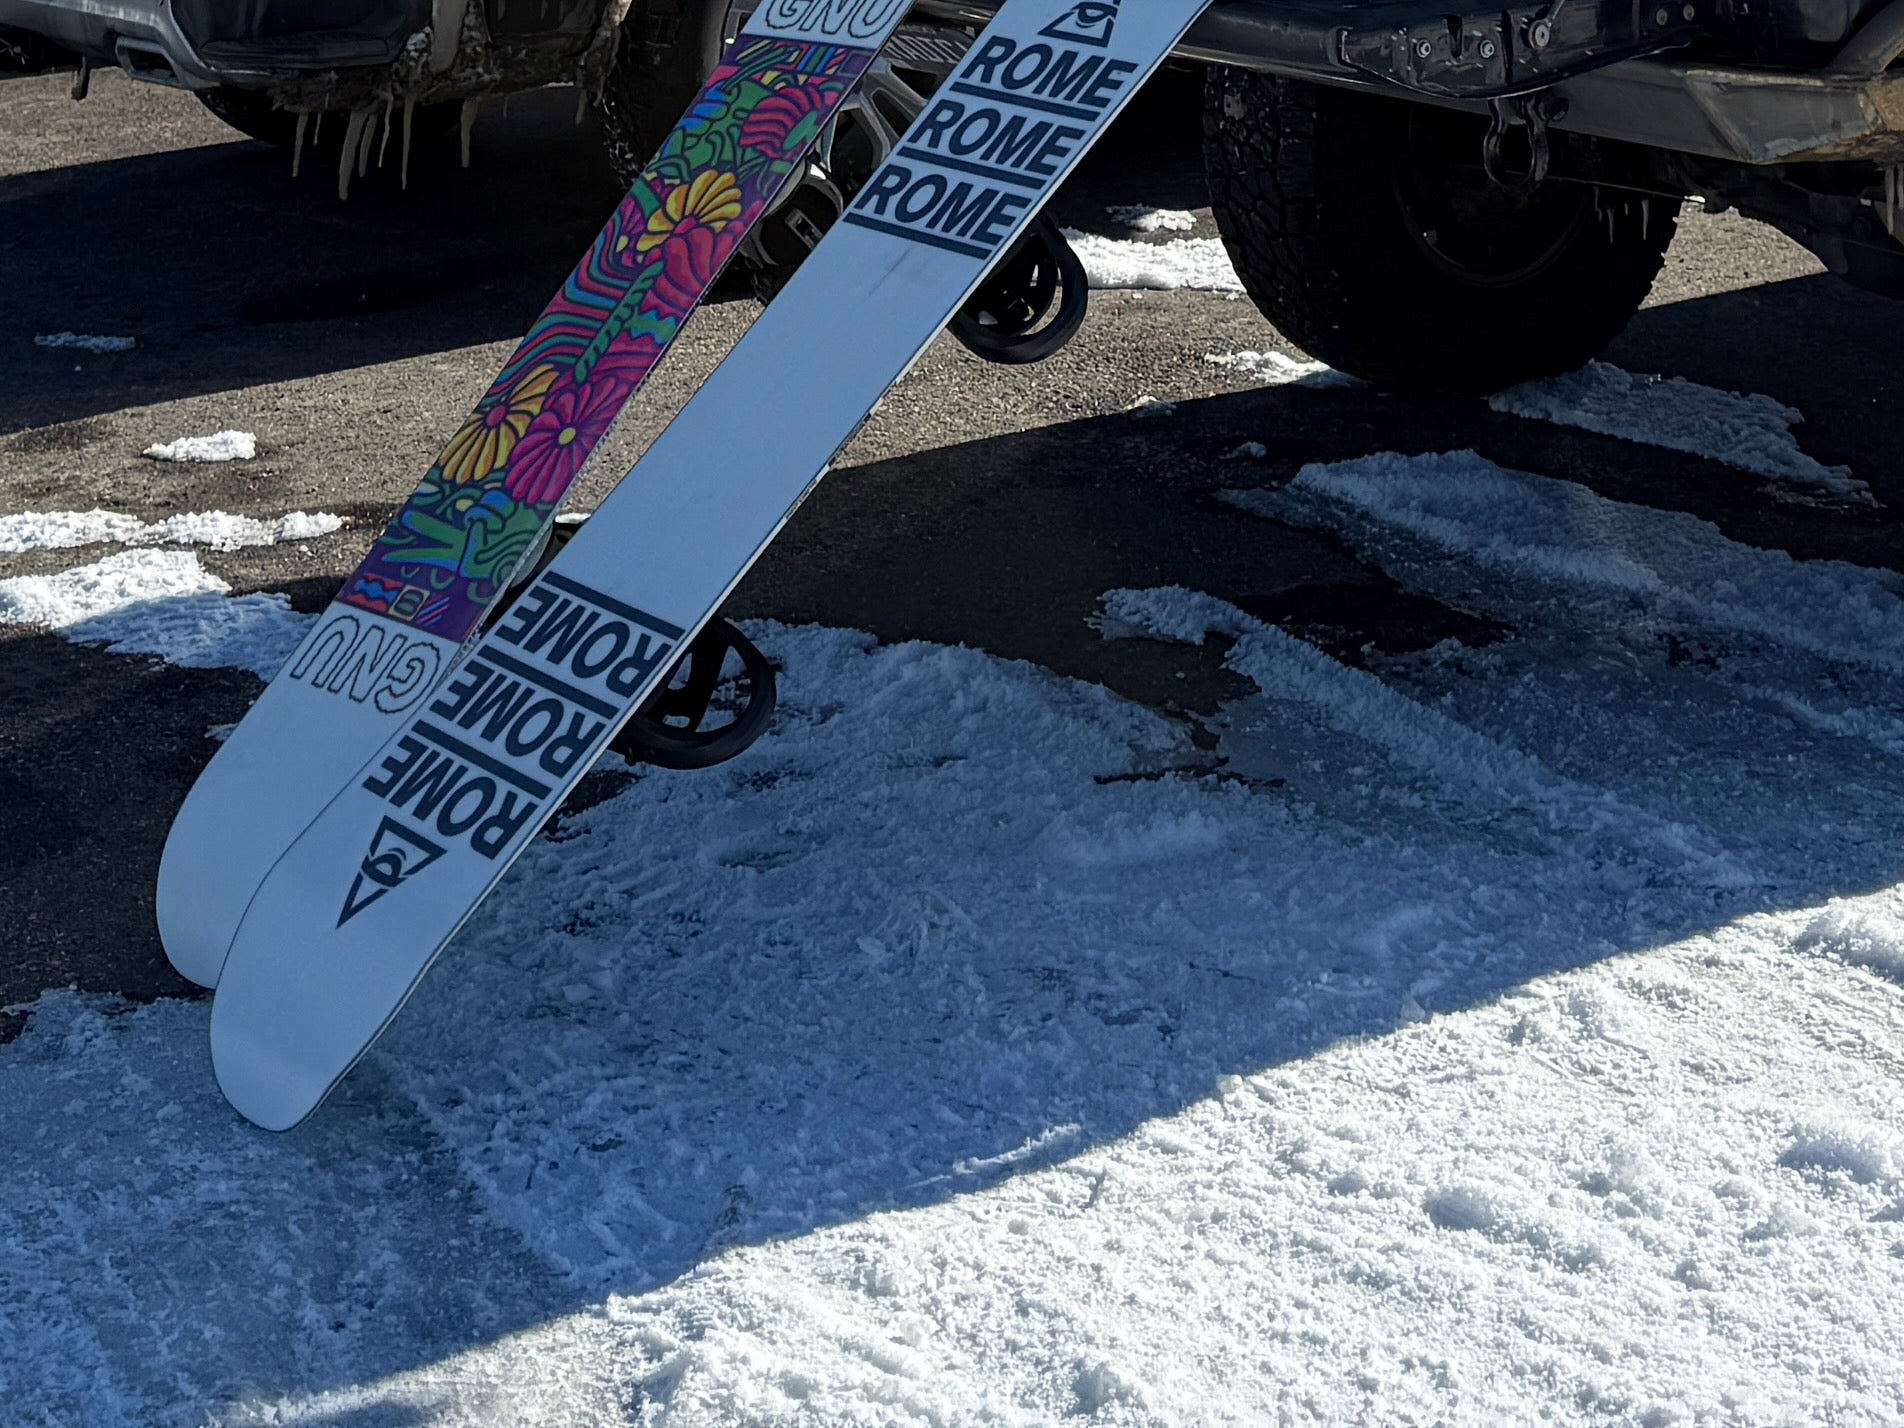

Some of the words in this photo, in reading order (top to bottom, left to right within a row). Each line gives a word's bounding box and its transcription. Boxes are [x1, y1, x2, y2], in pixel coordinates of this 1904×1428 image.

[959, 34, 1139, 109] ROME
[908, 98, 1087, 177] ROME
[854, 162, 1033, 245] ROME
[290, 613, 443, 714] GNU
[494, 584, 674, 700] ROME
[428, 655, 607, 778] ROME
[361, 734, 539, 861] ROME
